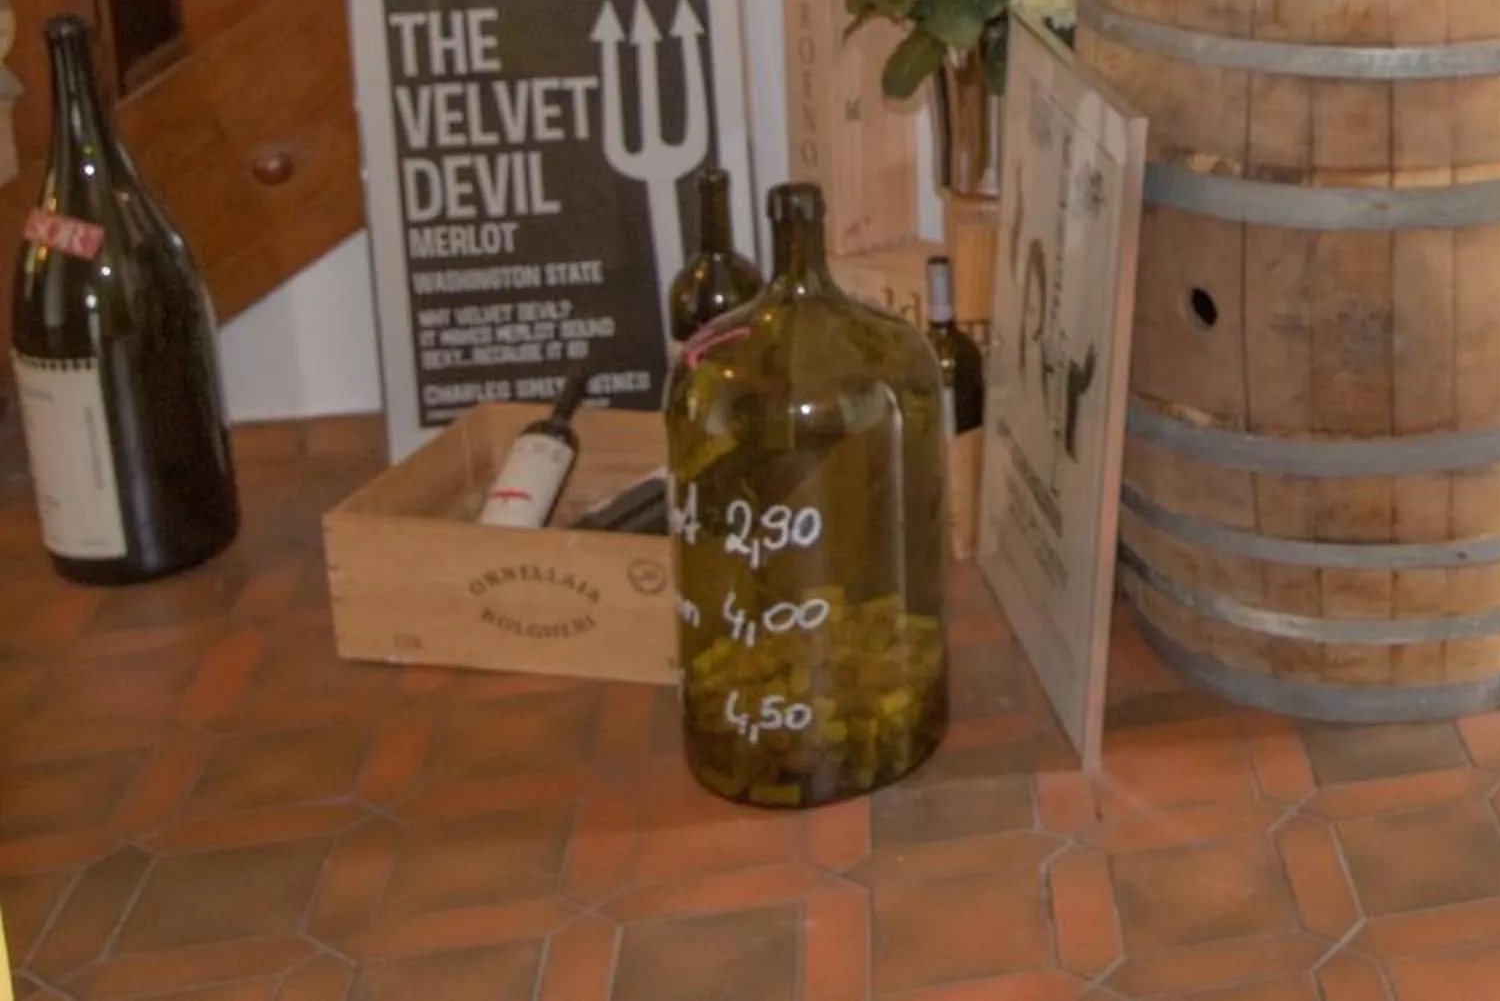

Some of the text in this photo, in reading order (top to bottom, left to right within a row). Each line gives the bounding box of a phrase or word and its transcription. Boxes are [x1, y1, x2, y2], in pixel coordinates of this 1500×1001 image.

[389, 8, 502, 78] THE
[395, 76, 599, 150] VELVET
[403, 151, 562, 223] DEVIL
[408, 222, 520, 258] MERLOT
[412, 261, 604, 294] WASHINGTON STATE
[725, 500, 821, 569] 2,90
[723, 591, 830, 647] 4,00
[725, 690, 813, 743] 4,50
